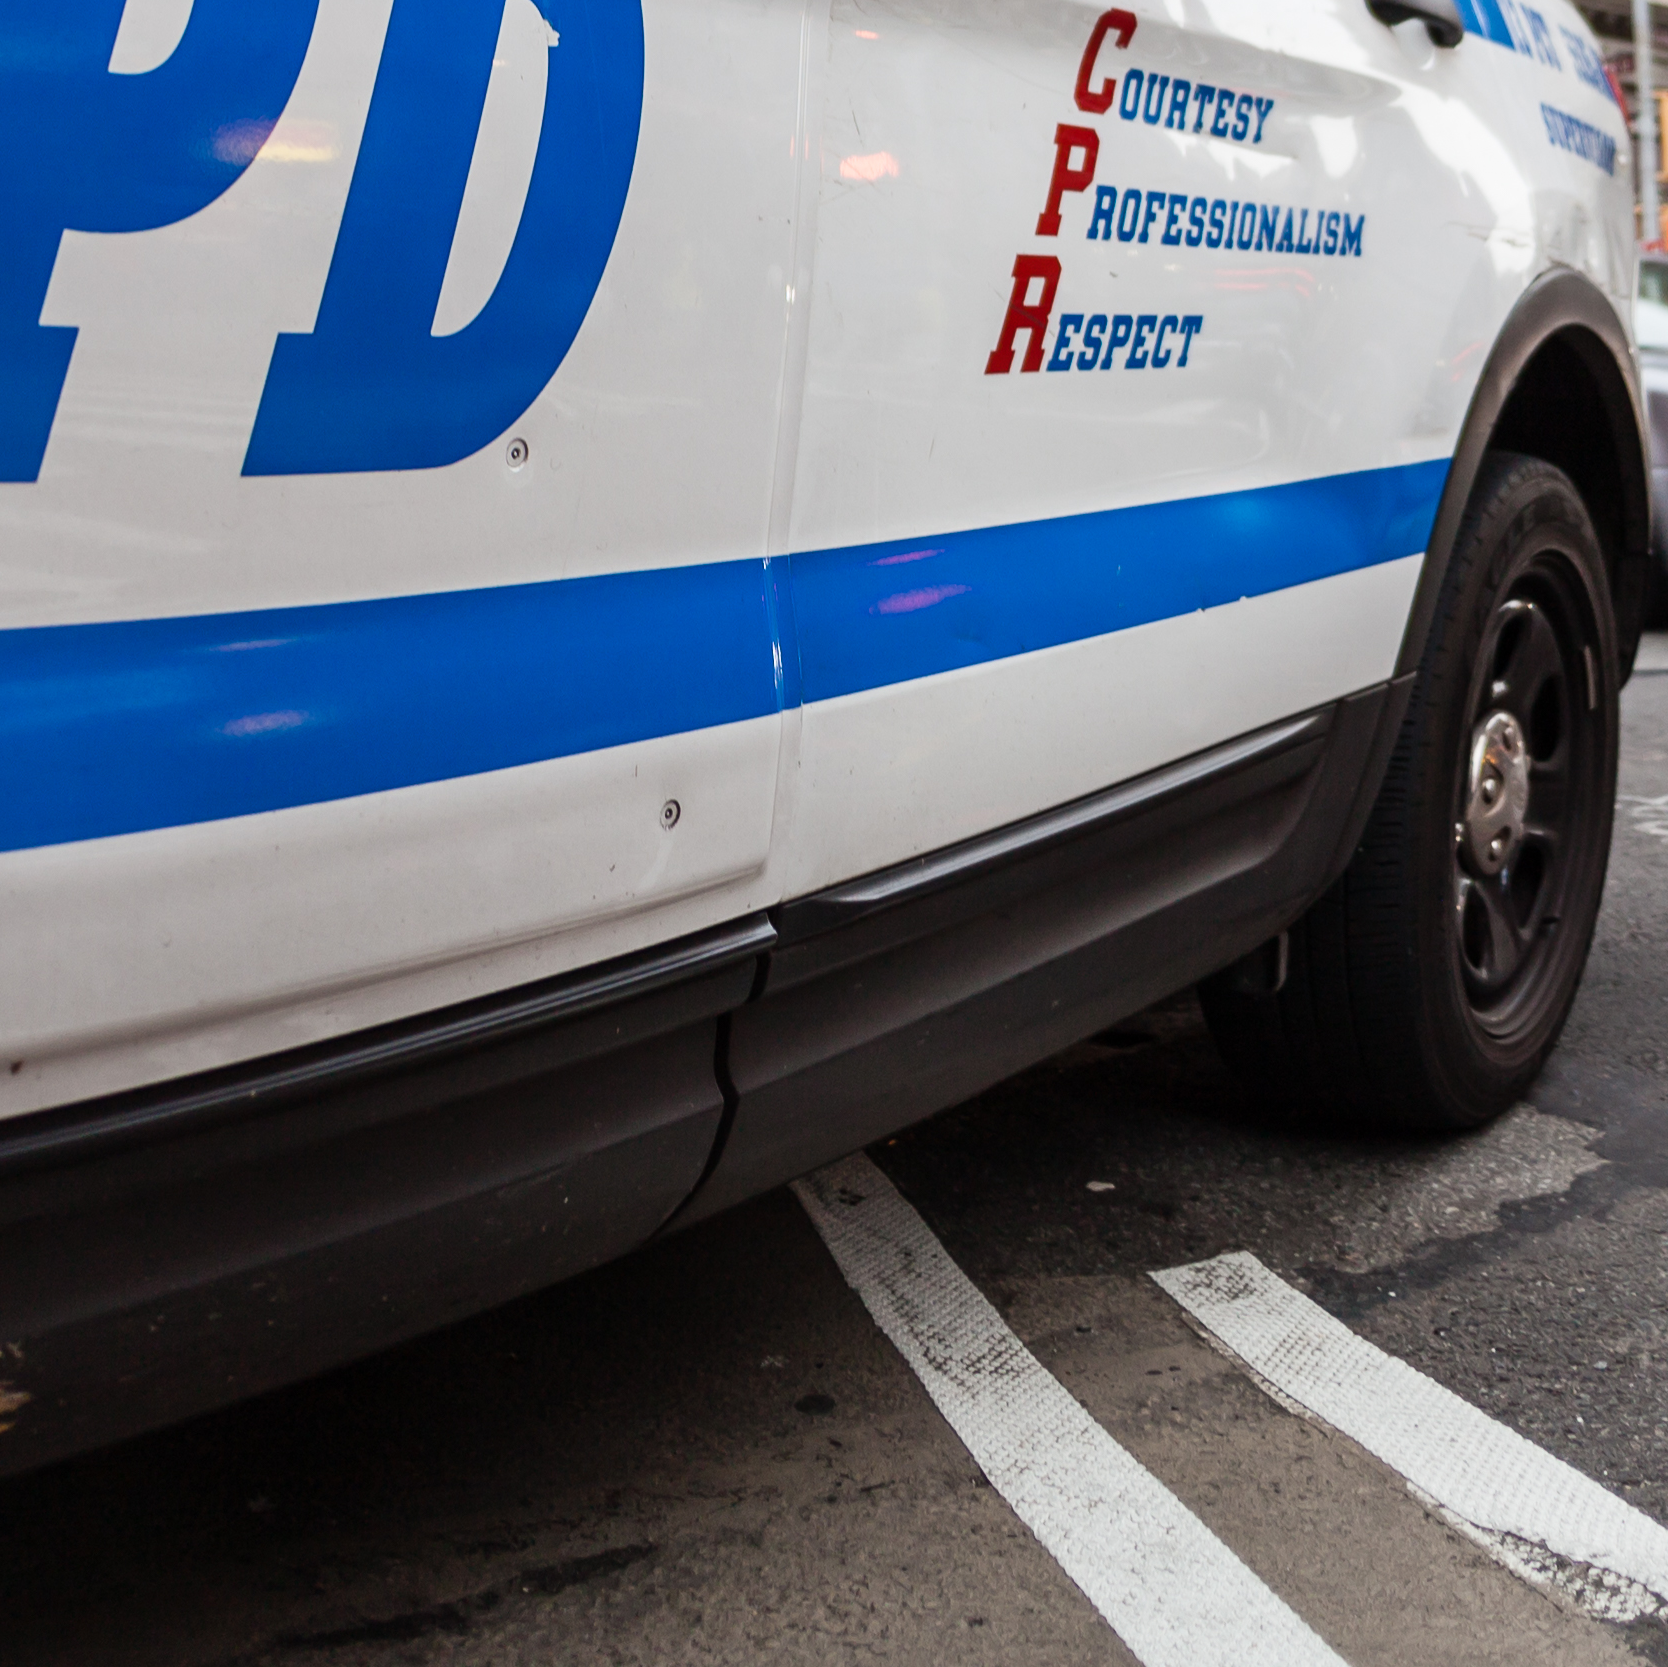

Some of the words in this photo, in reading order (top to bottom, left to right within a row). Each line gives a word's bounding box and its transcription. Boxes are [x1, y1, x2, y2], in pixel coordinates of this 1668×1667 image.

[1074, 8, 1274, 144] COURTESY
[1036, 124, 1366, 257] PROFESSIONALISM
[985, 254, 1203, 374] RESPECT
